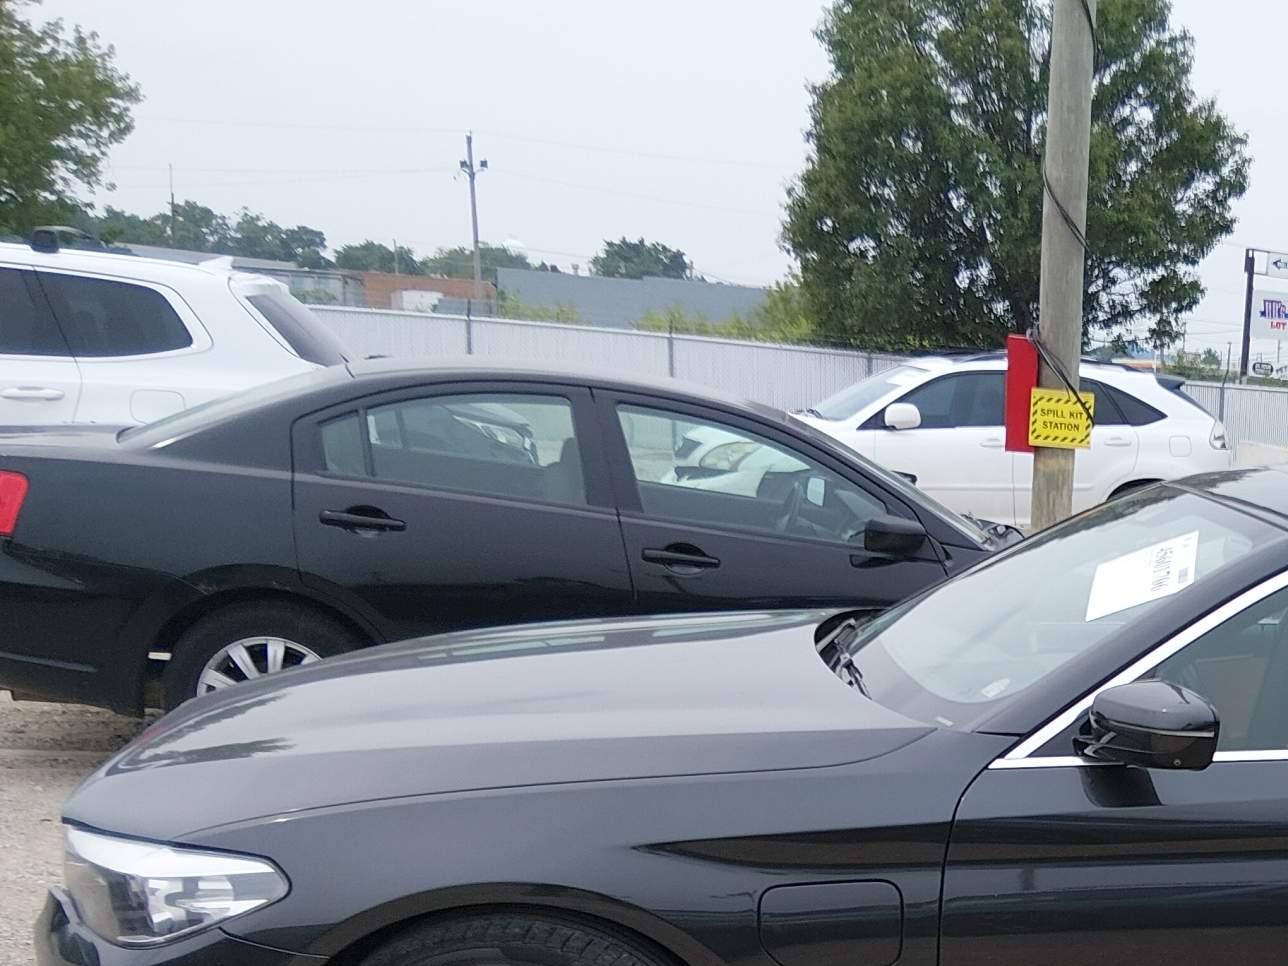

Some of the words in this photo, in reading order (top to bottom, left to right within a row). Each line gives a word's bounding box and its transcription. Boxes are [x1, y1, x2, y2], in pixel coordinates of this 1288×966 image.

[1270, 321, 1286, 331] LOT
[1040, 408, 1066, 419] SPILL
[1069, 411, 1083, 420] KIT
[1042, 421, 1080, 432] STATION
